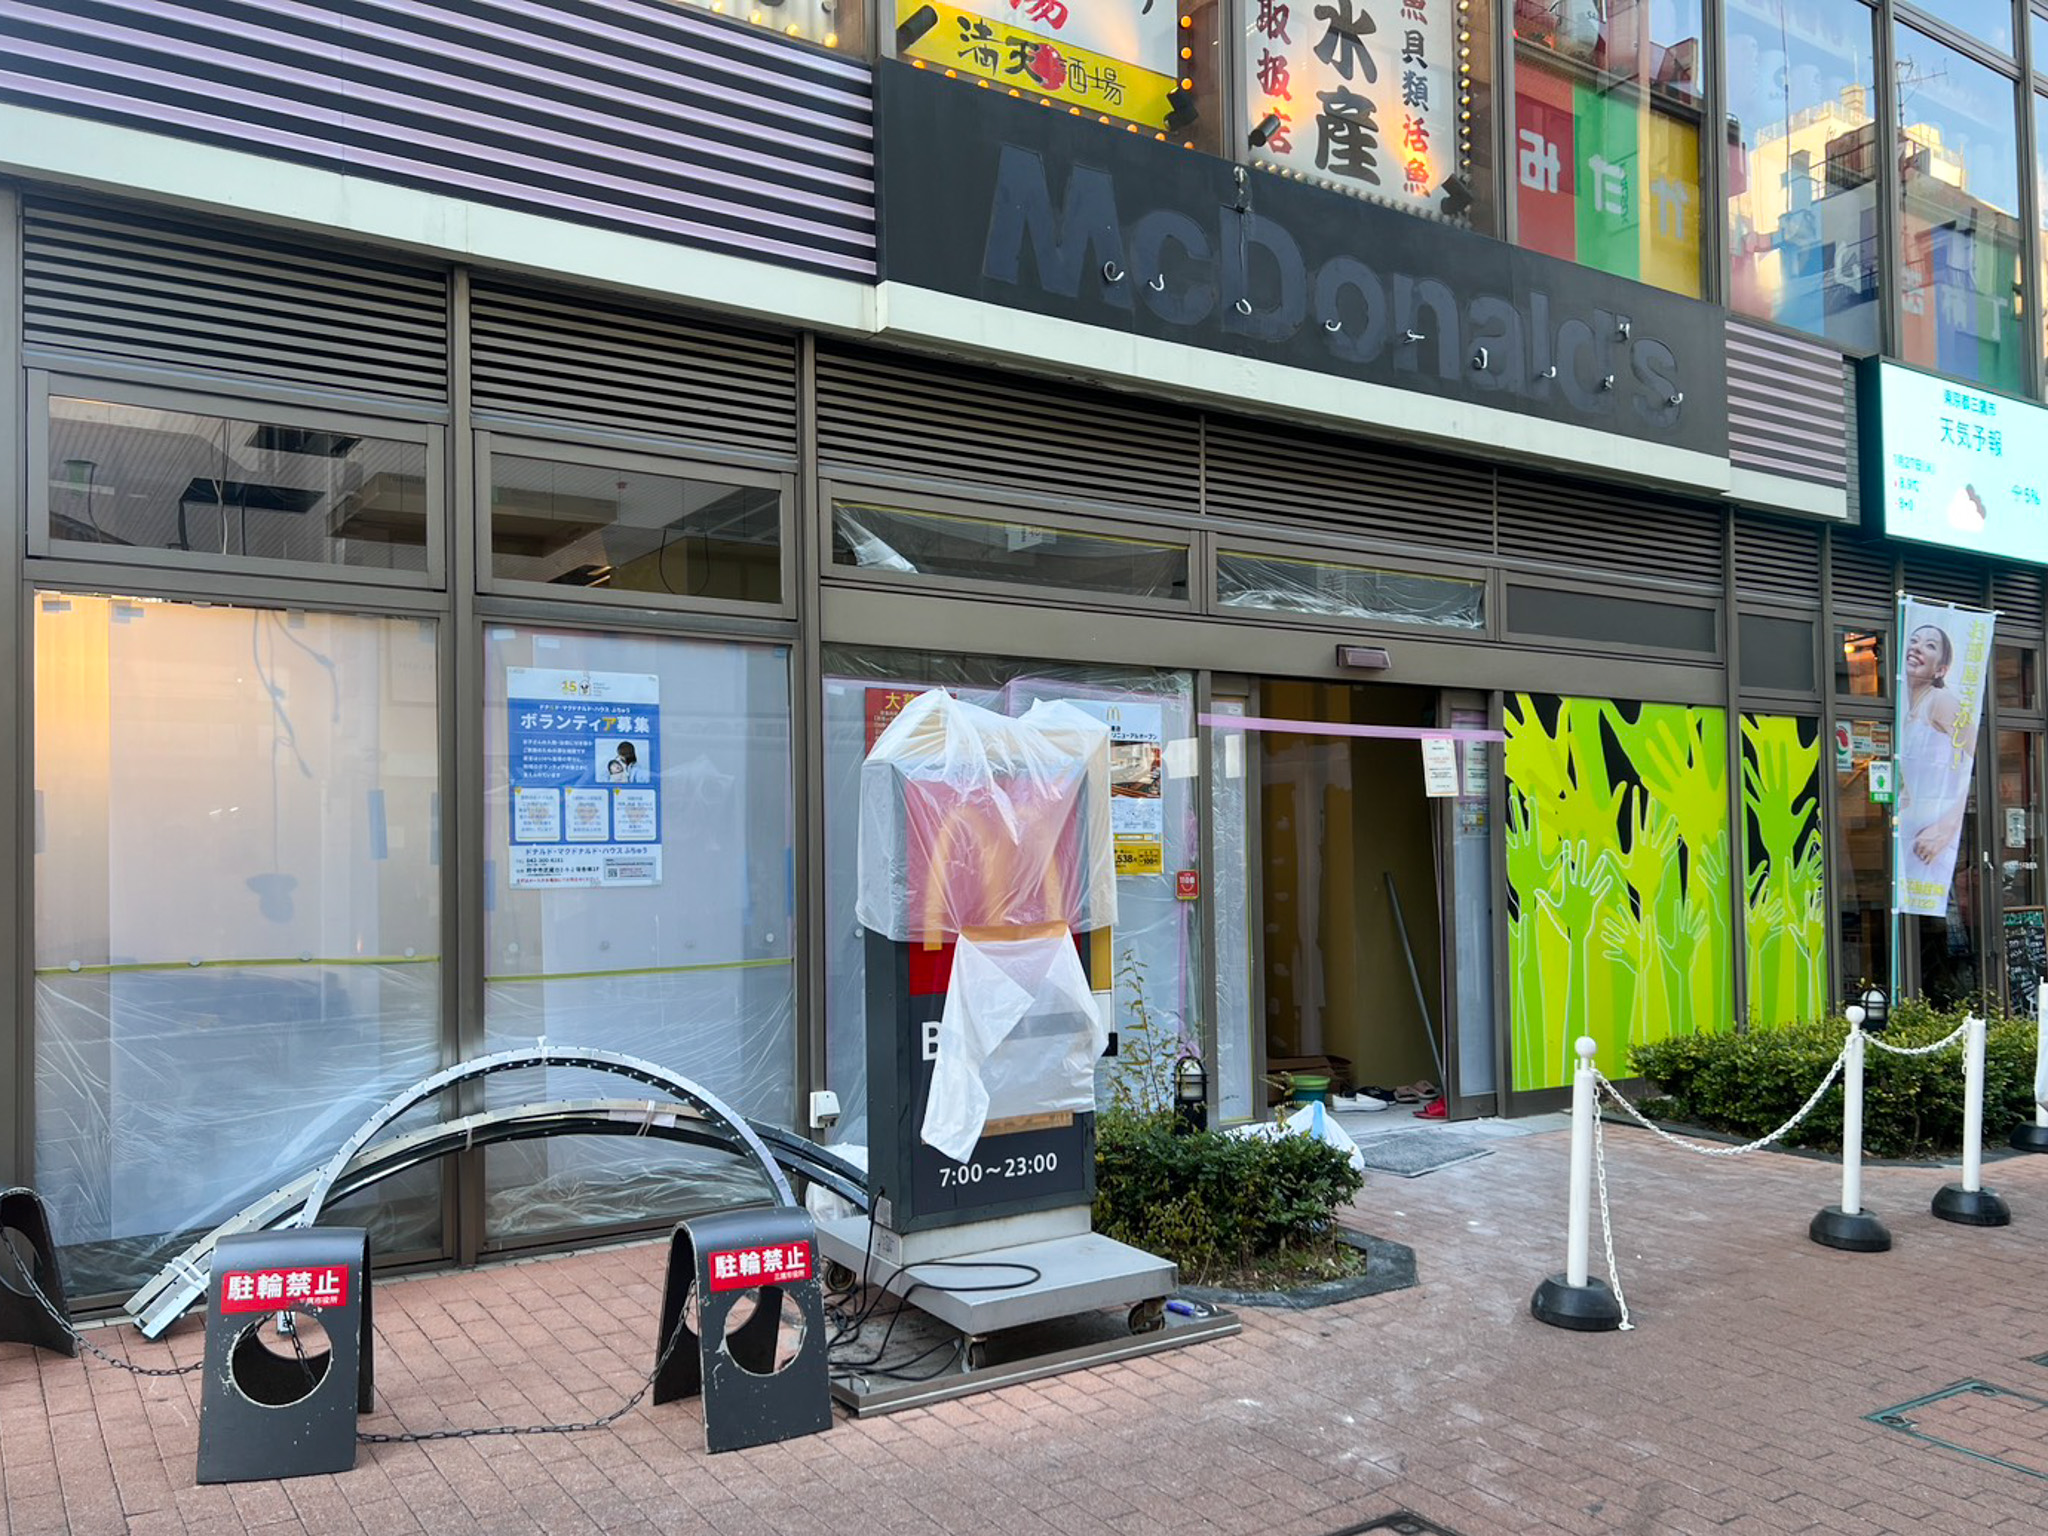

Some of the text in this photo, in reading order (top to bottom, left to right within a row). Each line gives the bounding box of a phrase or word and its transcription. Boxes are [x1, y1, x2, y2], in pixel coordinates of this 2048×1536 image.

[1313, 0, 1381, 186] 水産
[980, 140, 1682, 428] McDonald's
[1939, 417, 2003, 456] 天気予報
[520, 713, 650, 733] ボランティア募集
[715, 1246, 806, 1280] 駐輪禁止
[227, 1270, 341, 1301] 駐輪禁止
